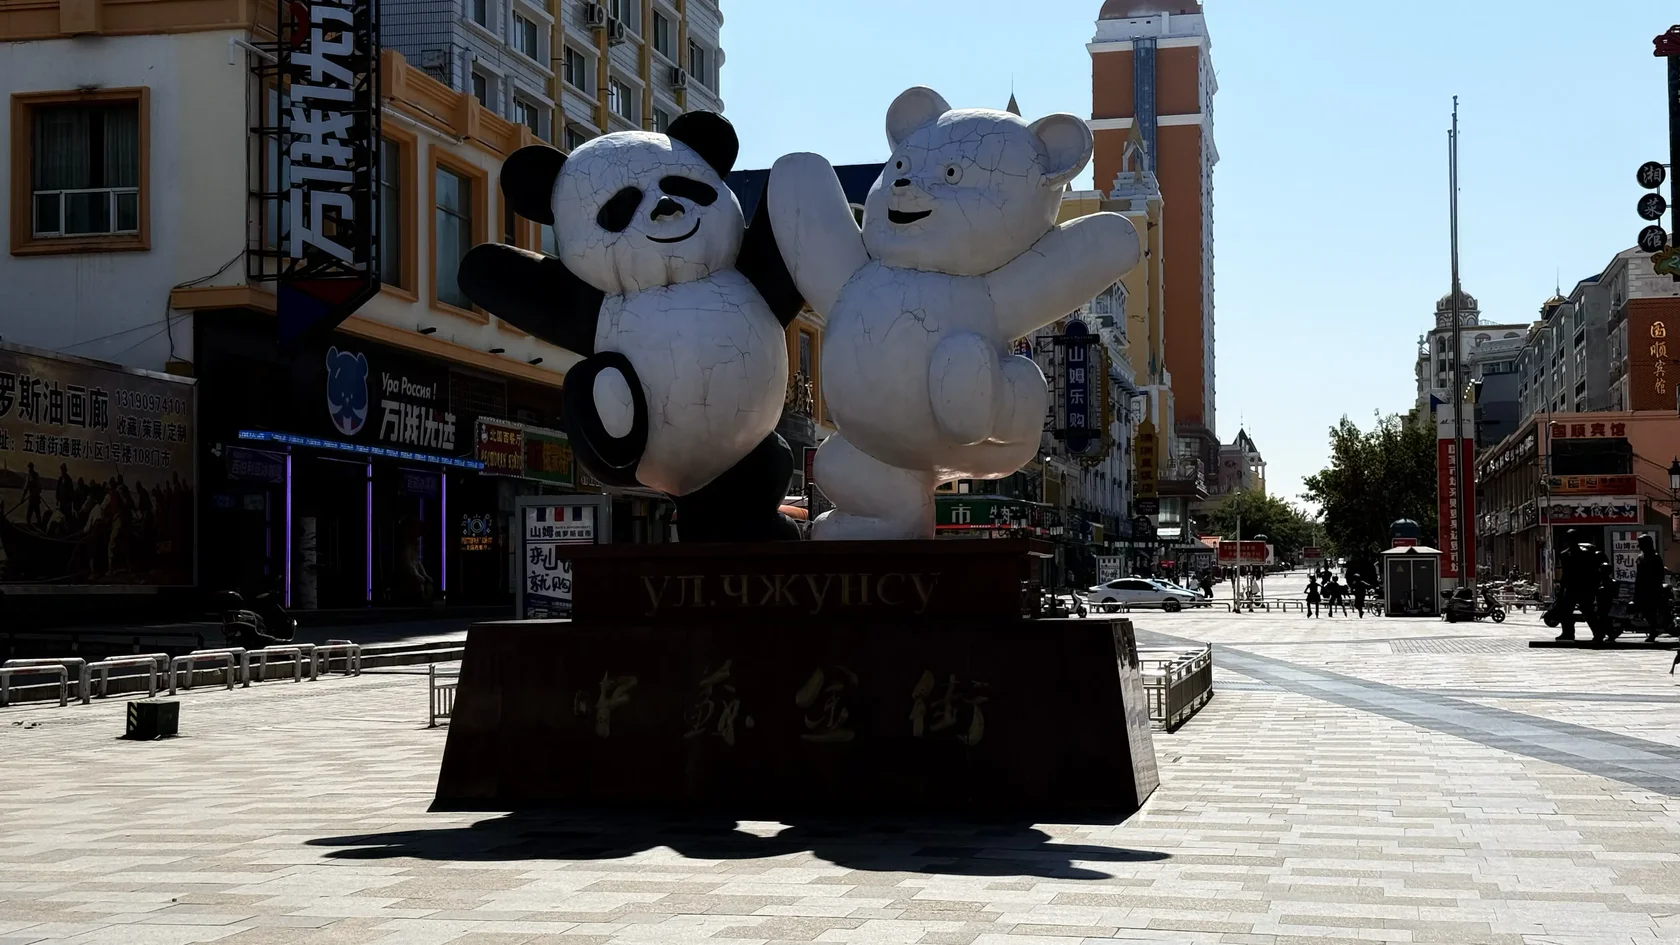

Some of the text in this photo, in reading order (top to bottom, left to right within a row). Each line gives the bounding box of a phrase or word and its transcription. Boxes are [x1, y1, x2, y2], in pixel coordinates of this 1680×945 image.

[290, 0, 355, 266] 万俄优
[1643, 166, 1663, 247] 湘菜馆
[0, 372, 109, 432] 罗斯油画廊
[116, 389, 187, 416] 13190974101
[381, 372, 400, 396] Ура
[1068, 345, 1085, 428] 山姆乐购
[530, 526, 554, 538] 山姆
[951, 503, 972, 524] 市
